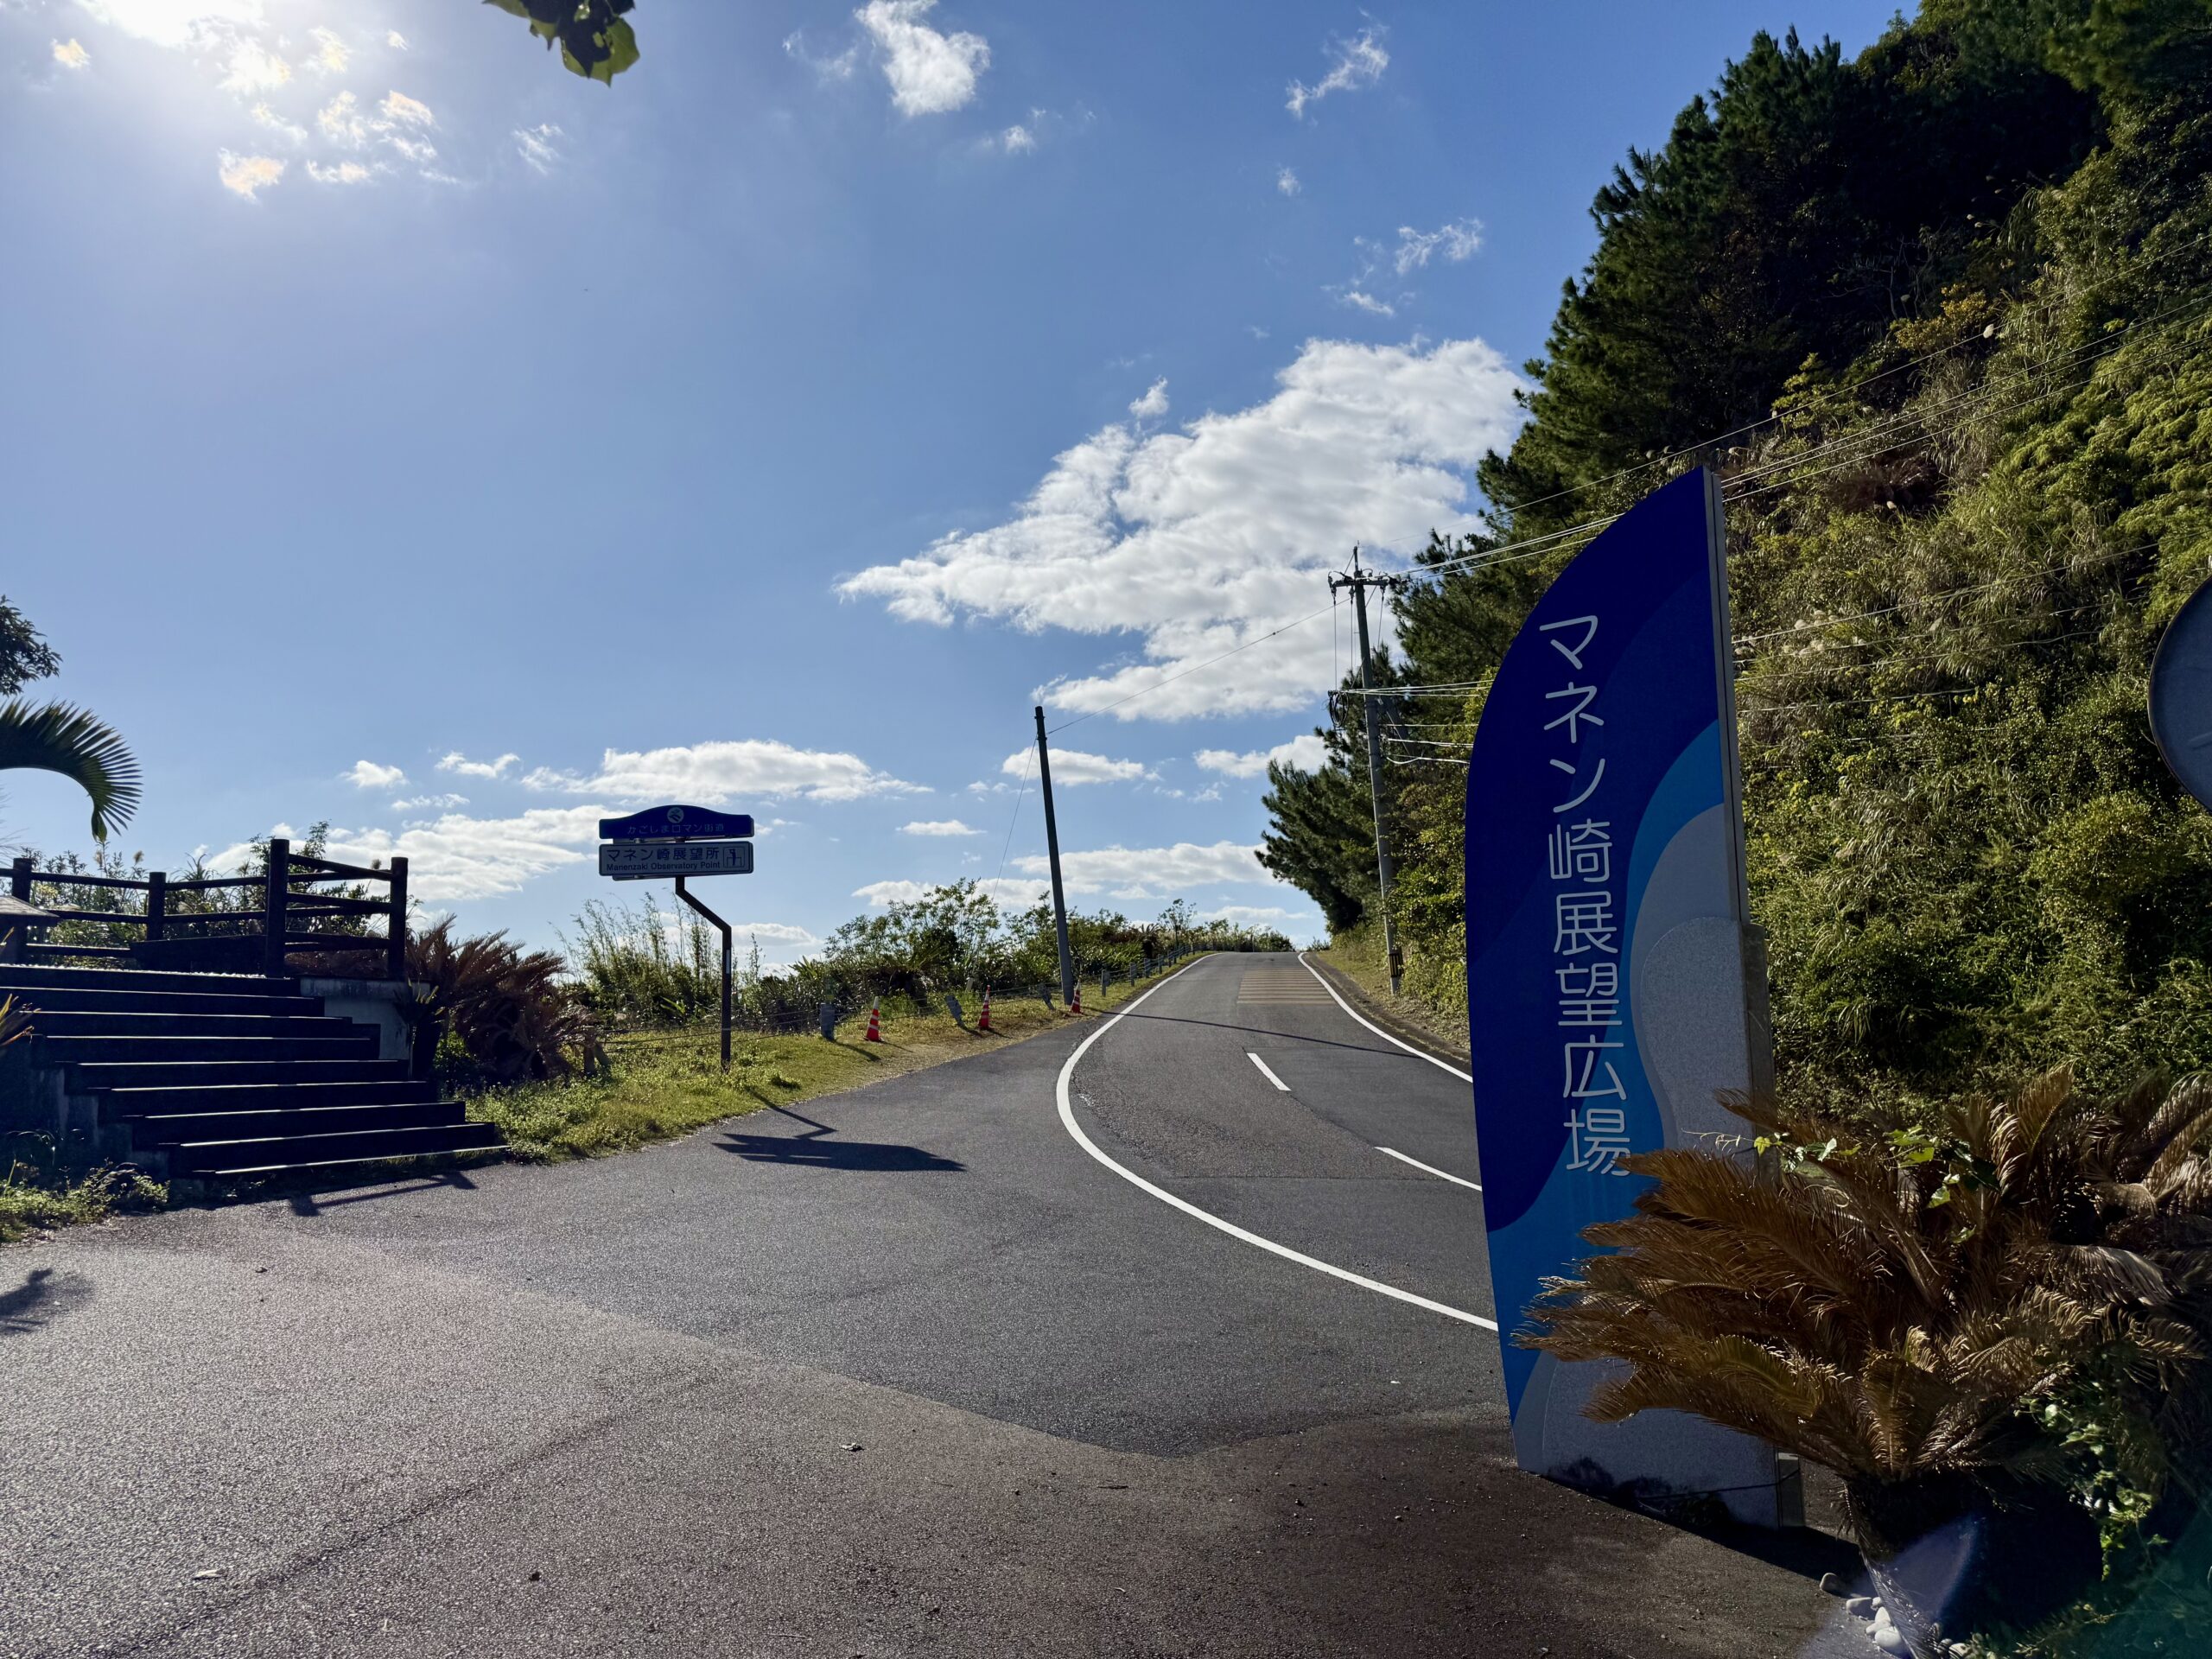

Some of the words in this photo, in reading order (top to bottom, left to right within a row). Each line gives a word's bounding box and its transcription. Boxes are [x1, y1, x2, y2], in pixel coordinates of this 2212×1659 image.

[627, 823, 725, 836] かごしまロマン街道
[607, 847, 720, 861] マネン崎展望所
[607, 862, 648, 871] Manenzaki
[651, 861, 698, 871] Observatory
[1538, 614, 1631, 1177] マネン崎展望広場
